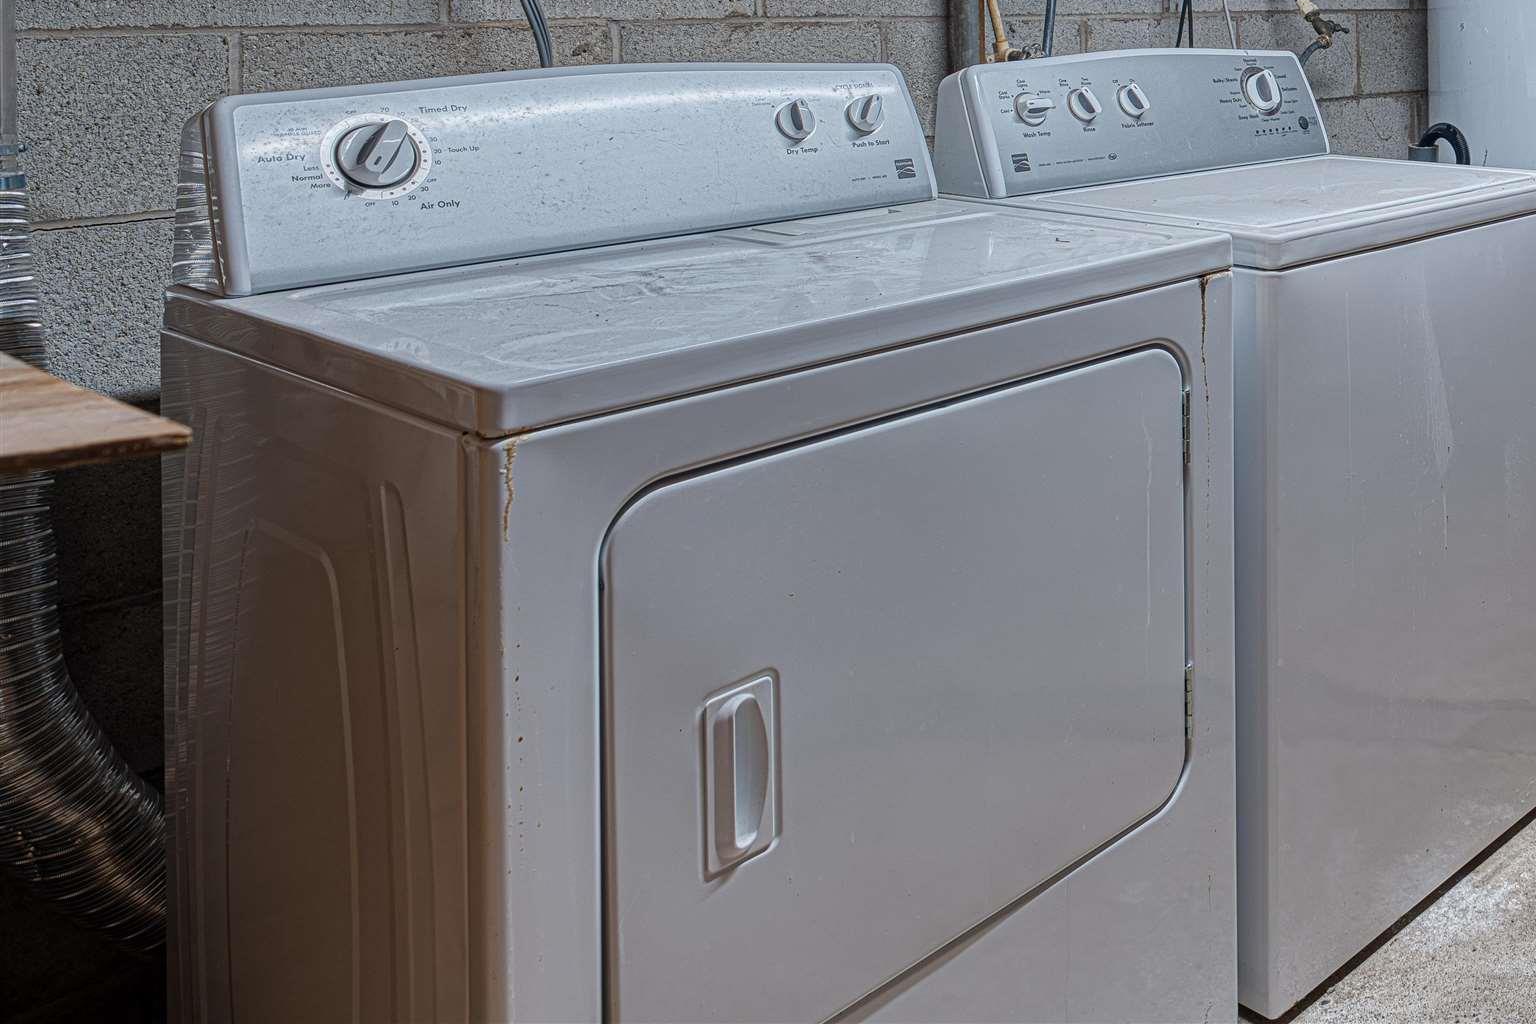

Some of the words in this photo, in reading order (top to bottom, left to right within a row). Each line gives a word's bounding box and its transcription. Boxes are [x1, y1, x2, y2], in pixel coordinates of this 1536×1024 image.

[419, 106, 448, 114] Timed
[450, 105, 468, 113] Dry
[257, 155, 283, 163] Auto
[286, 153, 307, 161] Dry
[291, 173, 324, 182] Normal
[420, 202, 435, 210] Air
[437, 199, 461, 208] Only
